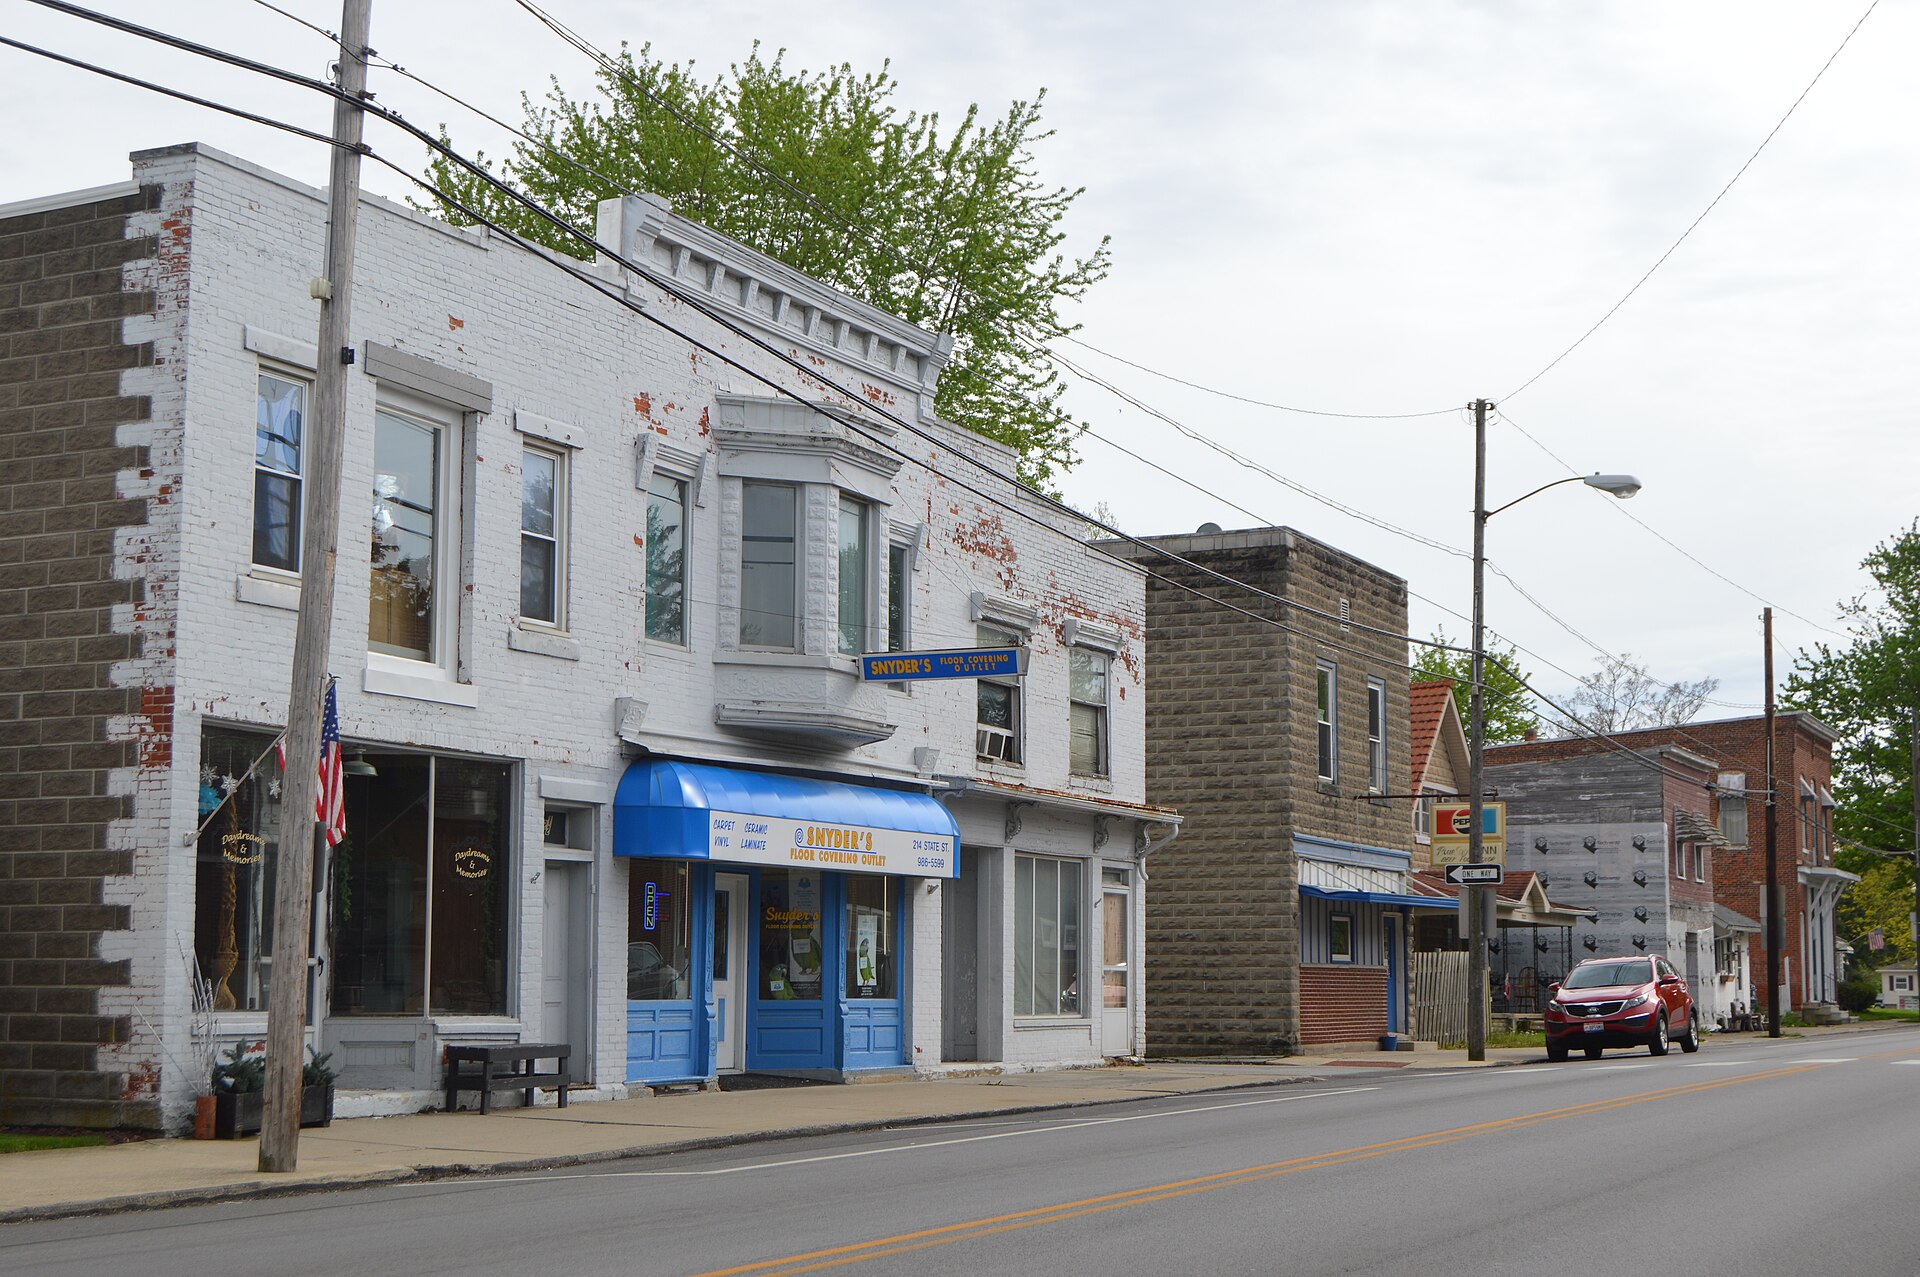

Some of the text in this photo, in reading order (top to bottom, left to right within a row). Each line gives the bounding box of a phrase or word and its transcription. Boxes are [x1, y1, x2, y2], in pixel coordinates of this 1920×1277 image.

[871, 654, 1009, 675] SNYDER'S FLOOR COVERING
[954, 663, 997, 672] OUTLET
[713, 819, 768, 835] CARPET CERAMIC
[222, 829, 266, 846] Daydreams
[714, 836, 767, 850] VINYL LAMINATE
[807, 826, 873, 851] SNYDER'S
[240, 843, 248, 854] &
[912, 840, 950, 852] 214 STATE ST.
[223, 848, 262, 864] Memories
[455, 847, 490, 862] Daydreams
[790, 848, 887, 867] FLOOR COVERING OUTLET
[469, 860, 476, 869] &
[917, 857, 945, 868] 986-5599
[456, 864, 489, 878] Memories
[646, 885, 654, 927] OPEN
[766, 905, 819, 923] Snyder's
